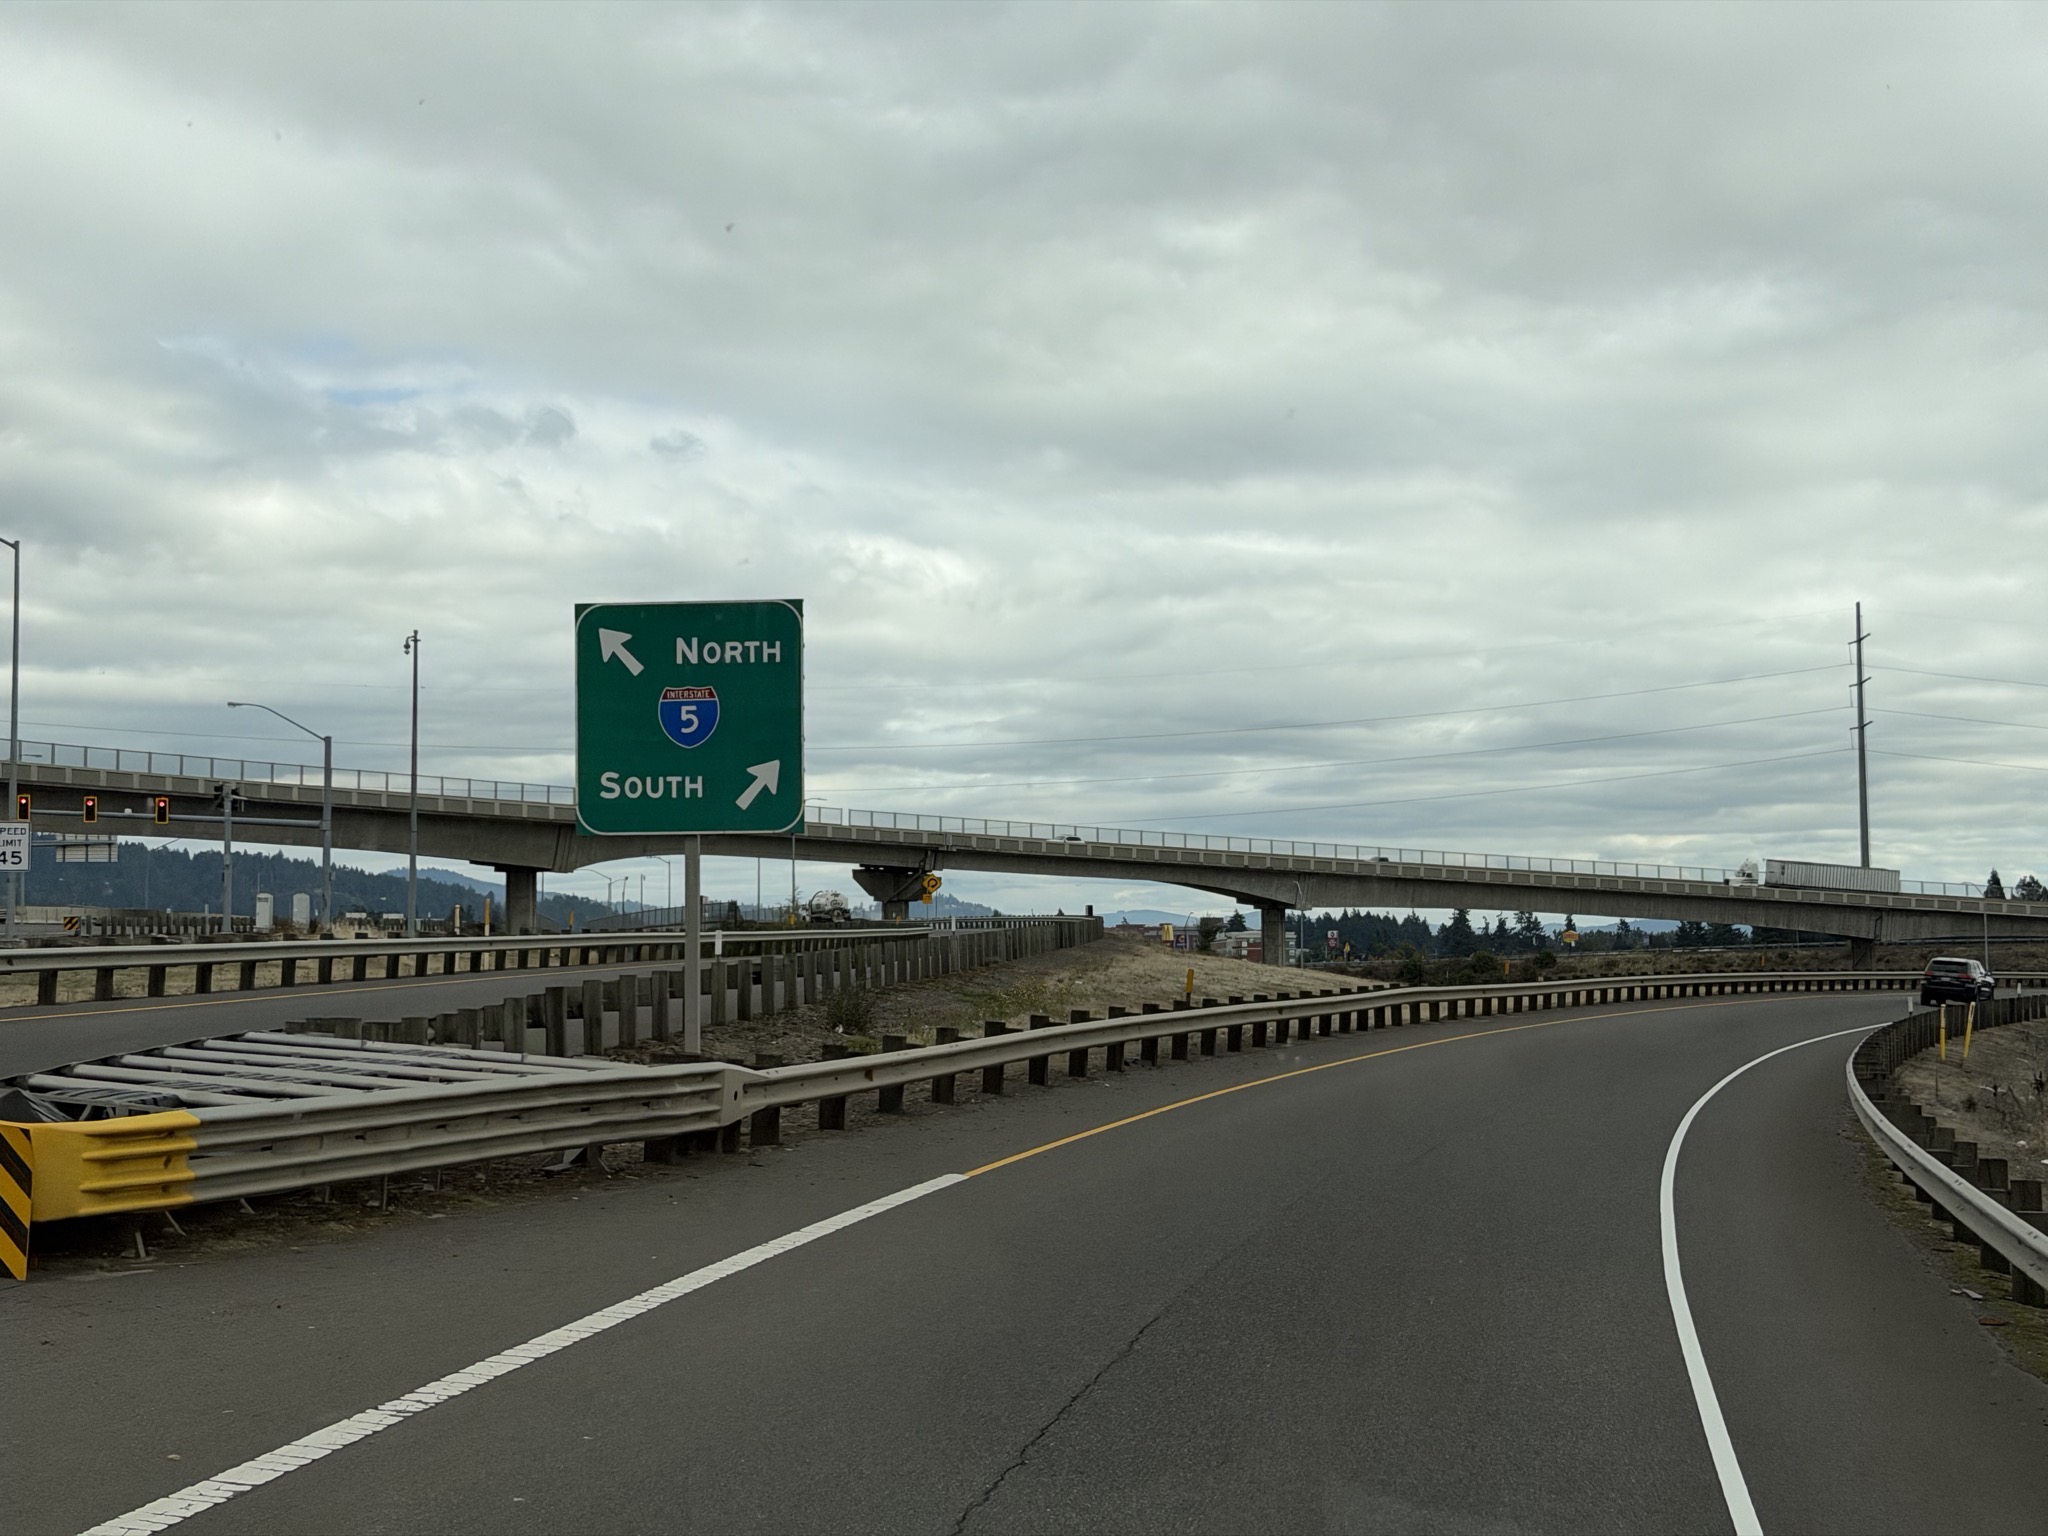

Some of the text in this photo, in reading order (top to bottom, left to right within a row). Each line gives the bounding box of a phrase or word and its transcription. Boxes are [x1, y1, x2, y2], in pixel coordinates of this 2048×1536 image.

[675, 637, 781, 664] NORTH
[667, 690, 711, 699] INTERSTATE
[681, 705, 699, 734] 5
[599, 771, 703, 799] SOUTH
[0, 827, 26, 835] PEED
[0, 839, 22, 847] IMIT
[0, 851, 22, 865] 45
